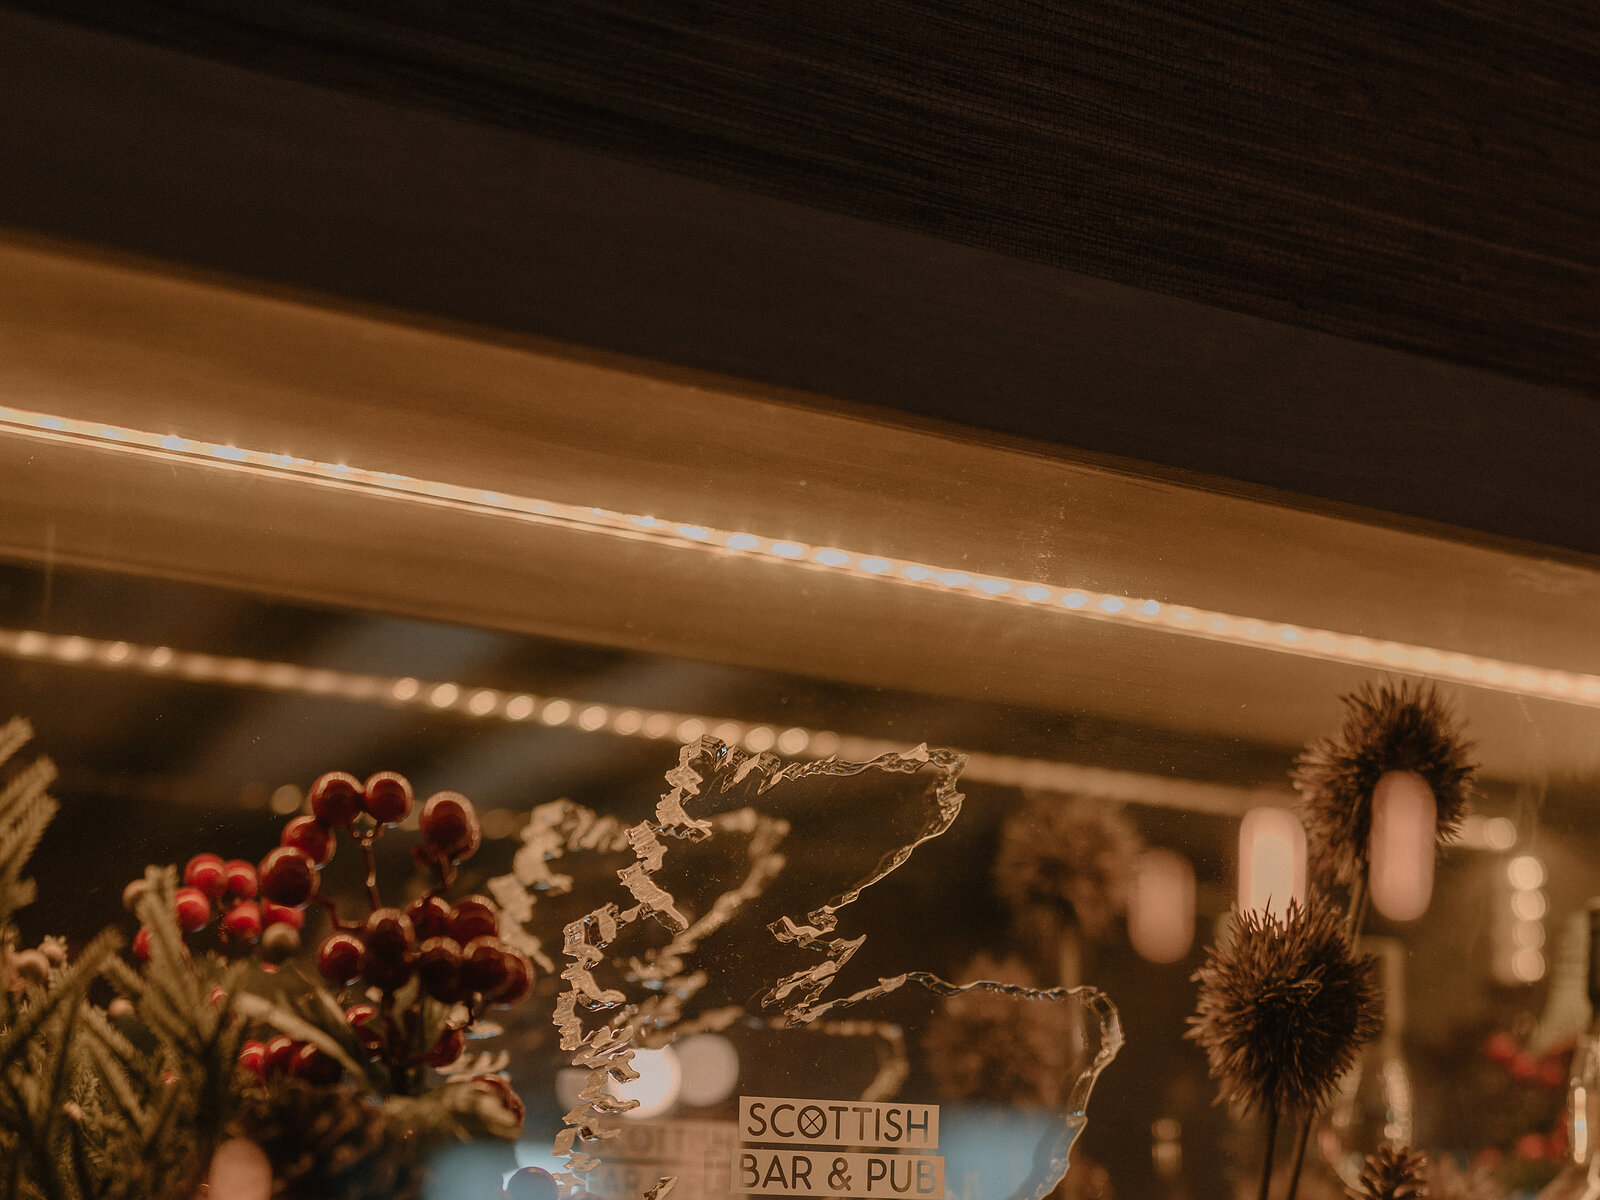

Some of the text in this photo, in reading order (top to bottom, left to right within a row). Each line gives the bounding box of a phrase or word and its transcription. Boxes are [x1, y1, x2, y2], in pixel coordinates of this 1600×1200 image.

[747, 1102, 929, 1143] SCOTTISH
[740, 1153, 812, 1190] BAR
[827, 1157, 852, 1191] &
[866, 1158, 937, 1194] PUB
